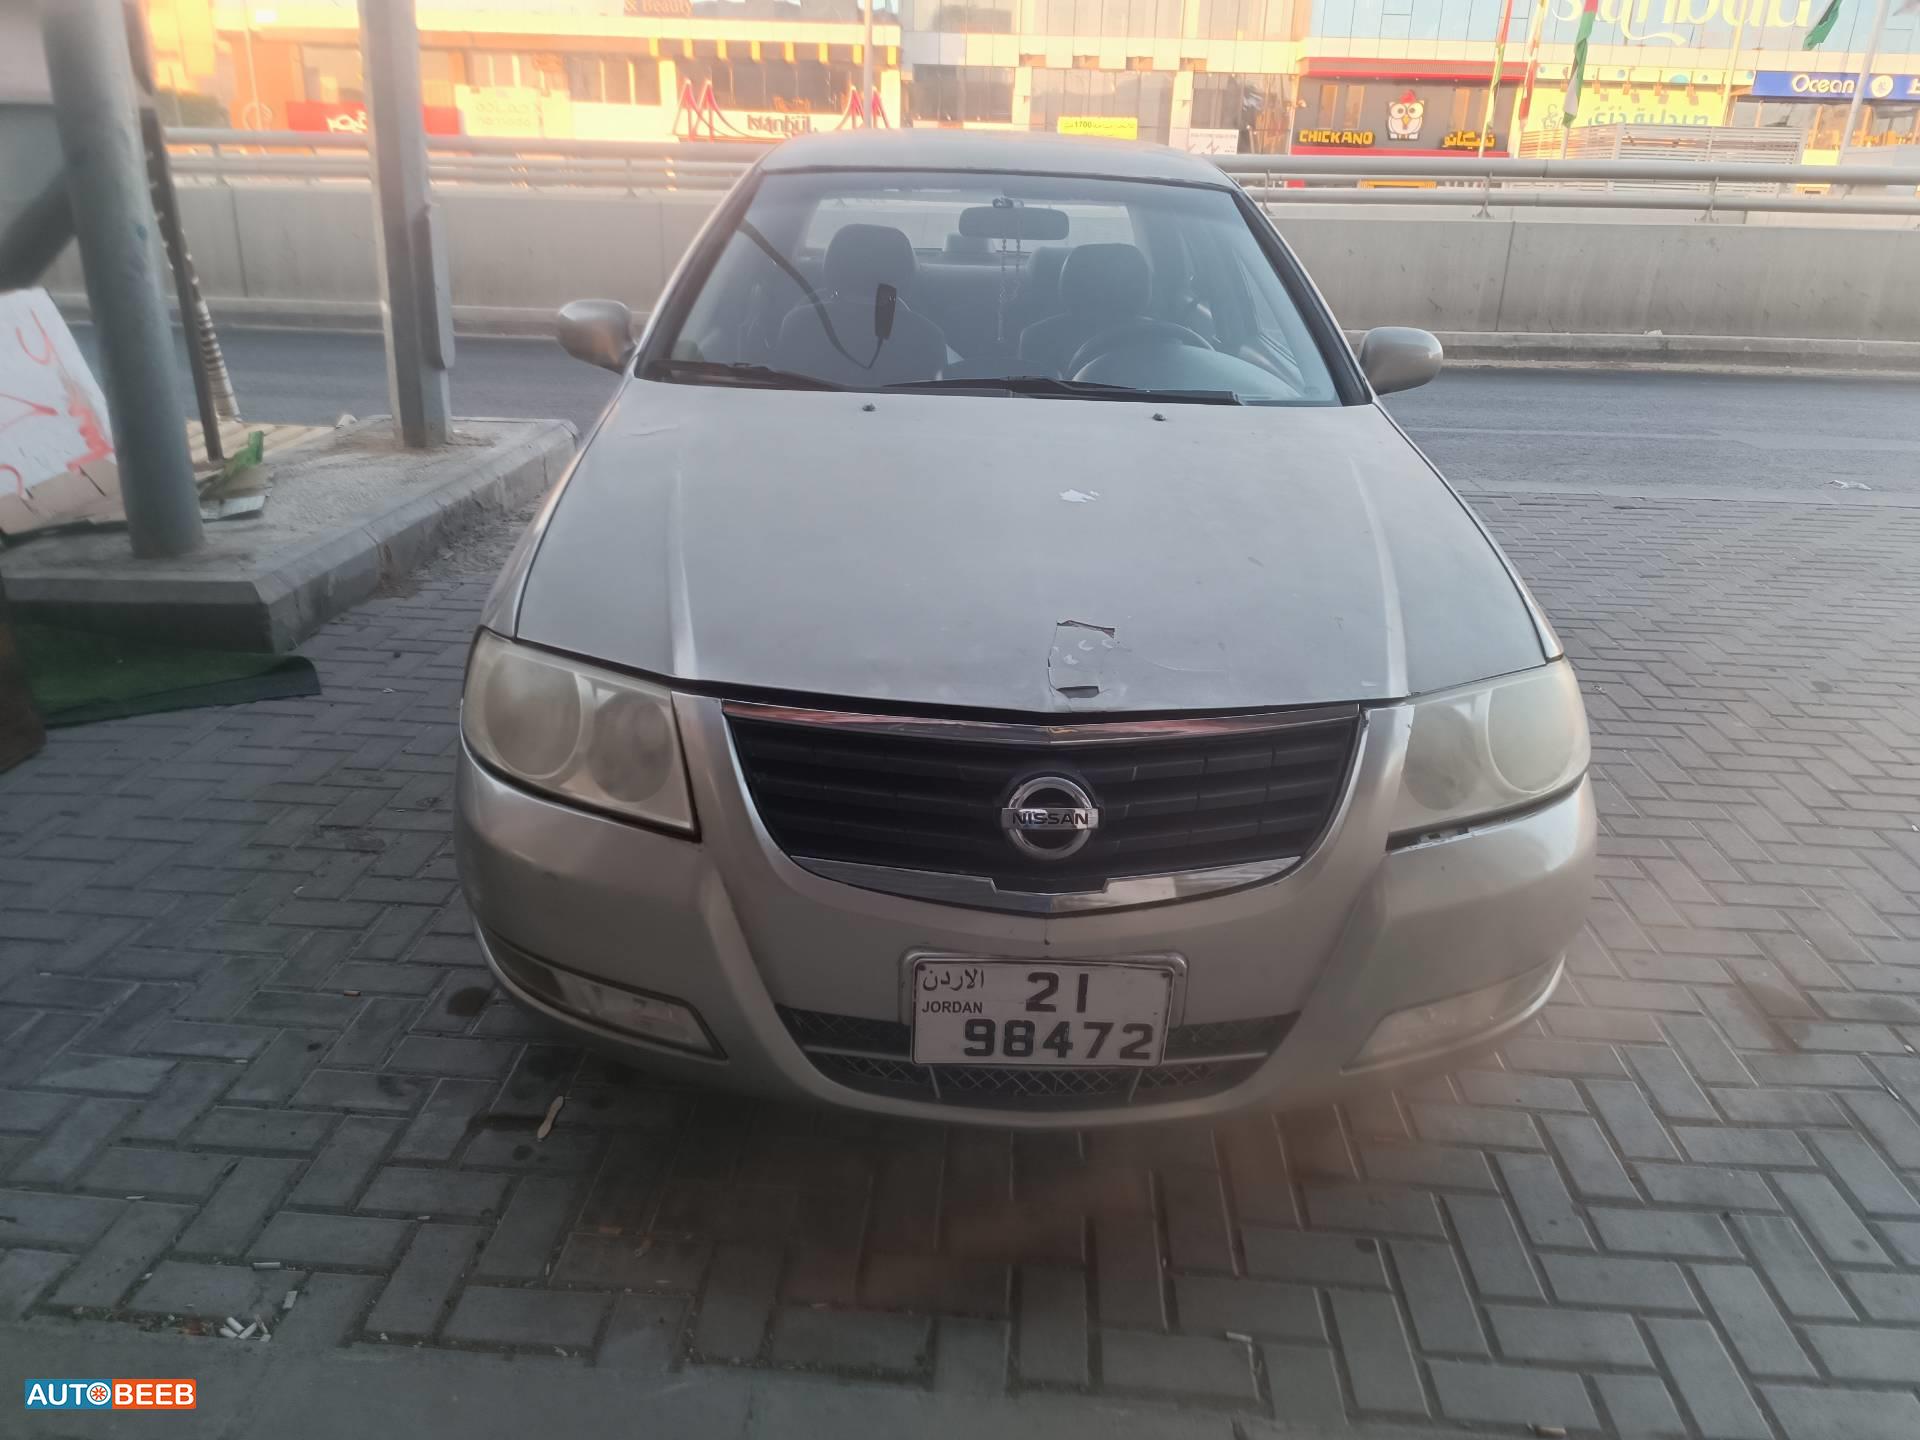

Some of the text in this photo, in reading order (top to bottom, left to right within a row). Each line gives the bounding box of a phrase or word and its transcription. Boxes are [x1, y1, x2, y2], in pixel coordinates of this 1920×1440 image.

[1791, 74, 1855, 94] Ocean
[1299, 129, 1374, 145] CHICKANO
[1012, 812, 1089, 825] NISSAN
[921, 1000, 983, 1014] JORDAN
[963, 1018, 1154, 1060] 98472
